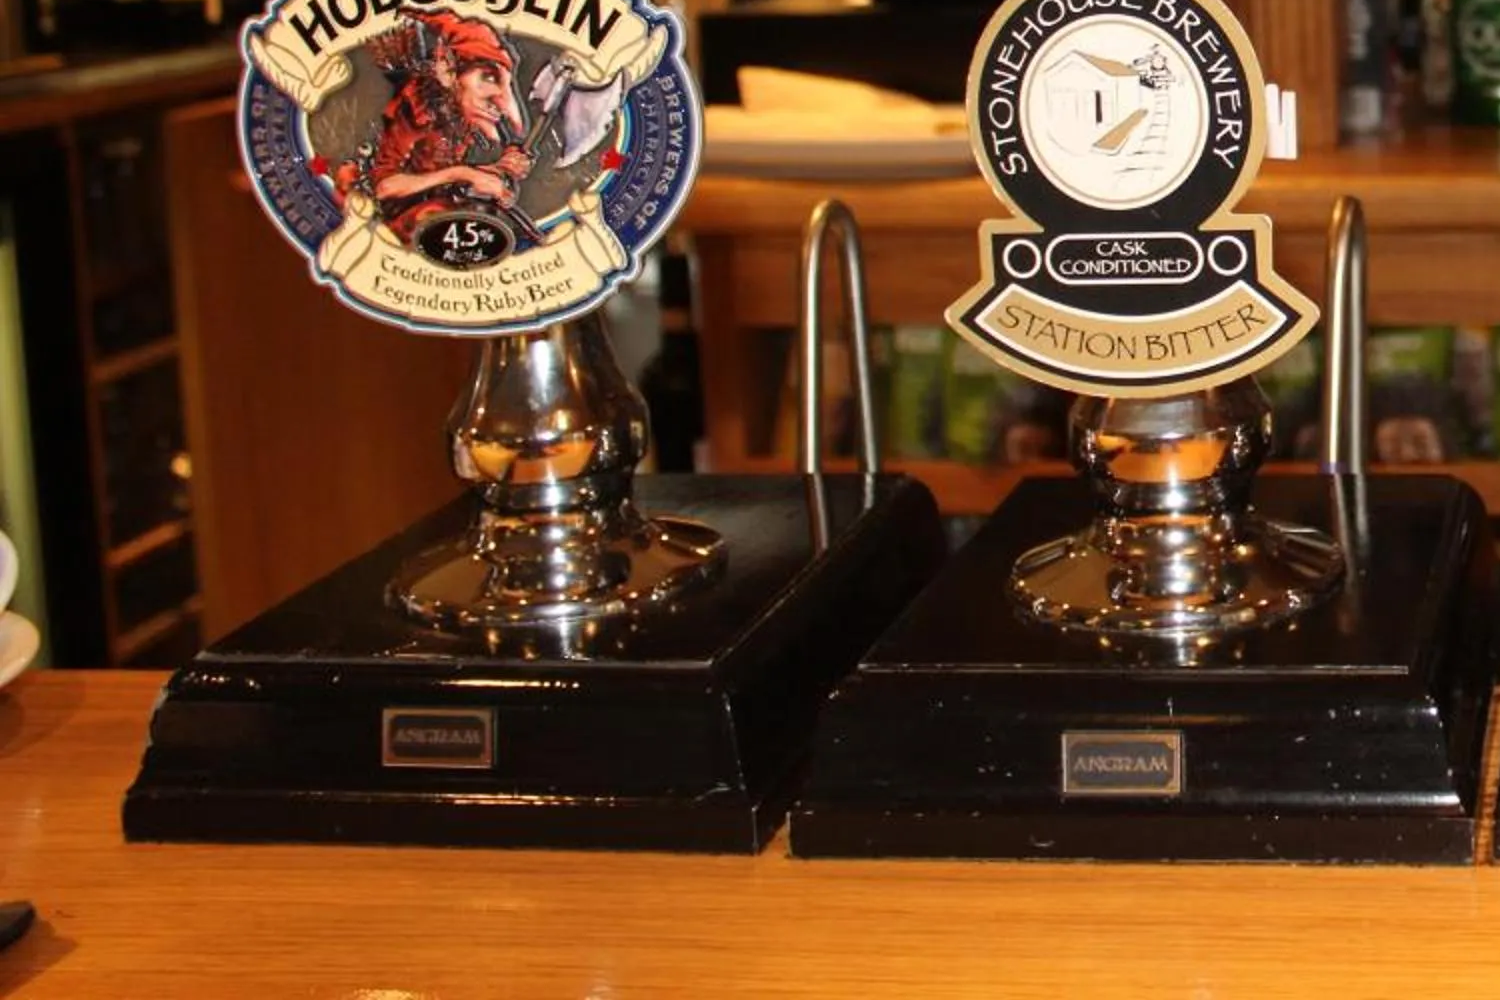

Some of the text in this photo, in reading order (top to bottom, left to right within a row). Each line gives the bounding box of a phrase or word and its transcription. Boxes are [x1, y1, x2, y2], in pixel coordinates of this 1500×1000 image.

[633, 75, 684, 231] BREWERS OF
[442, 221, 495, 250] 4.5%
[1095, 241, 1148, 258] CASK
[380, 251, 566, 291] Traditionally Crafted
[1059, 257, 1192, 276] CONDITIONED
[373, 275, 574, 315] Legendary Ruby Beer
[997, 302, 1267, 362] STATION BITTER
